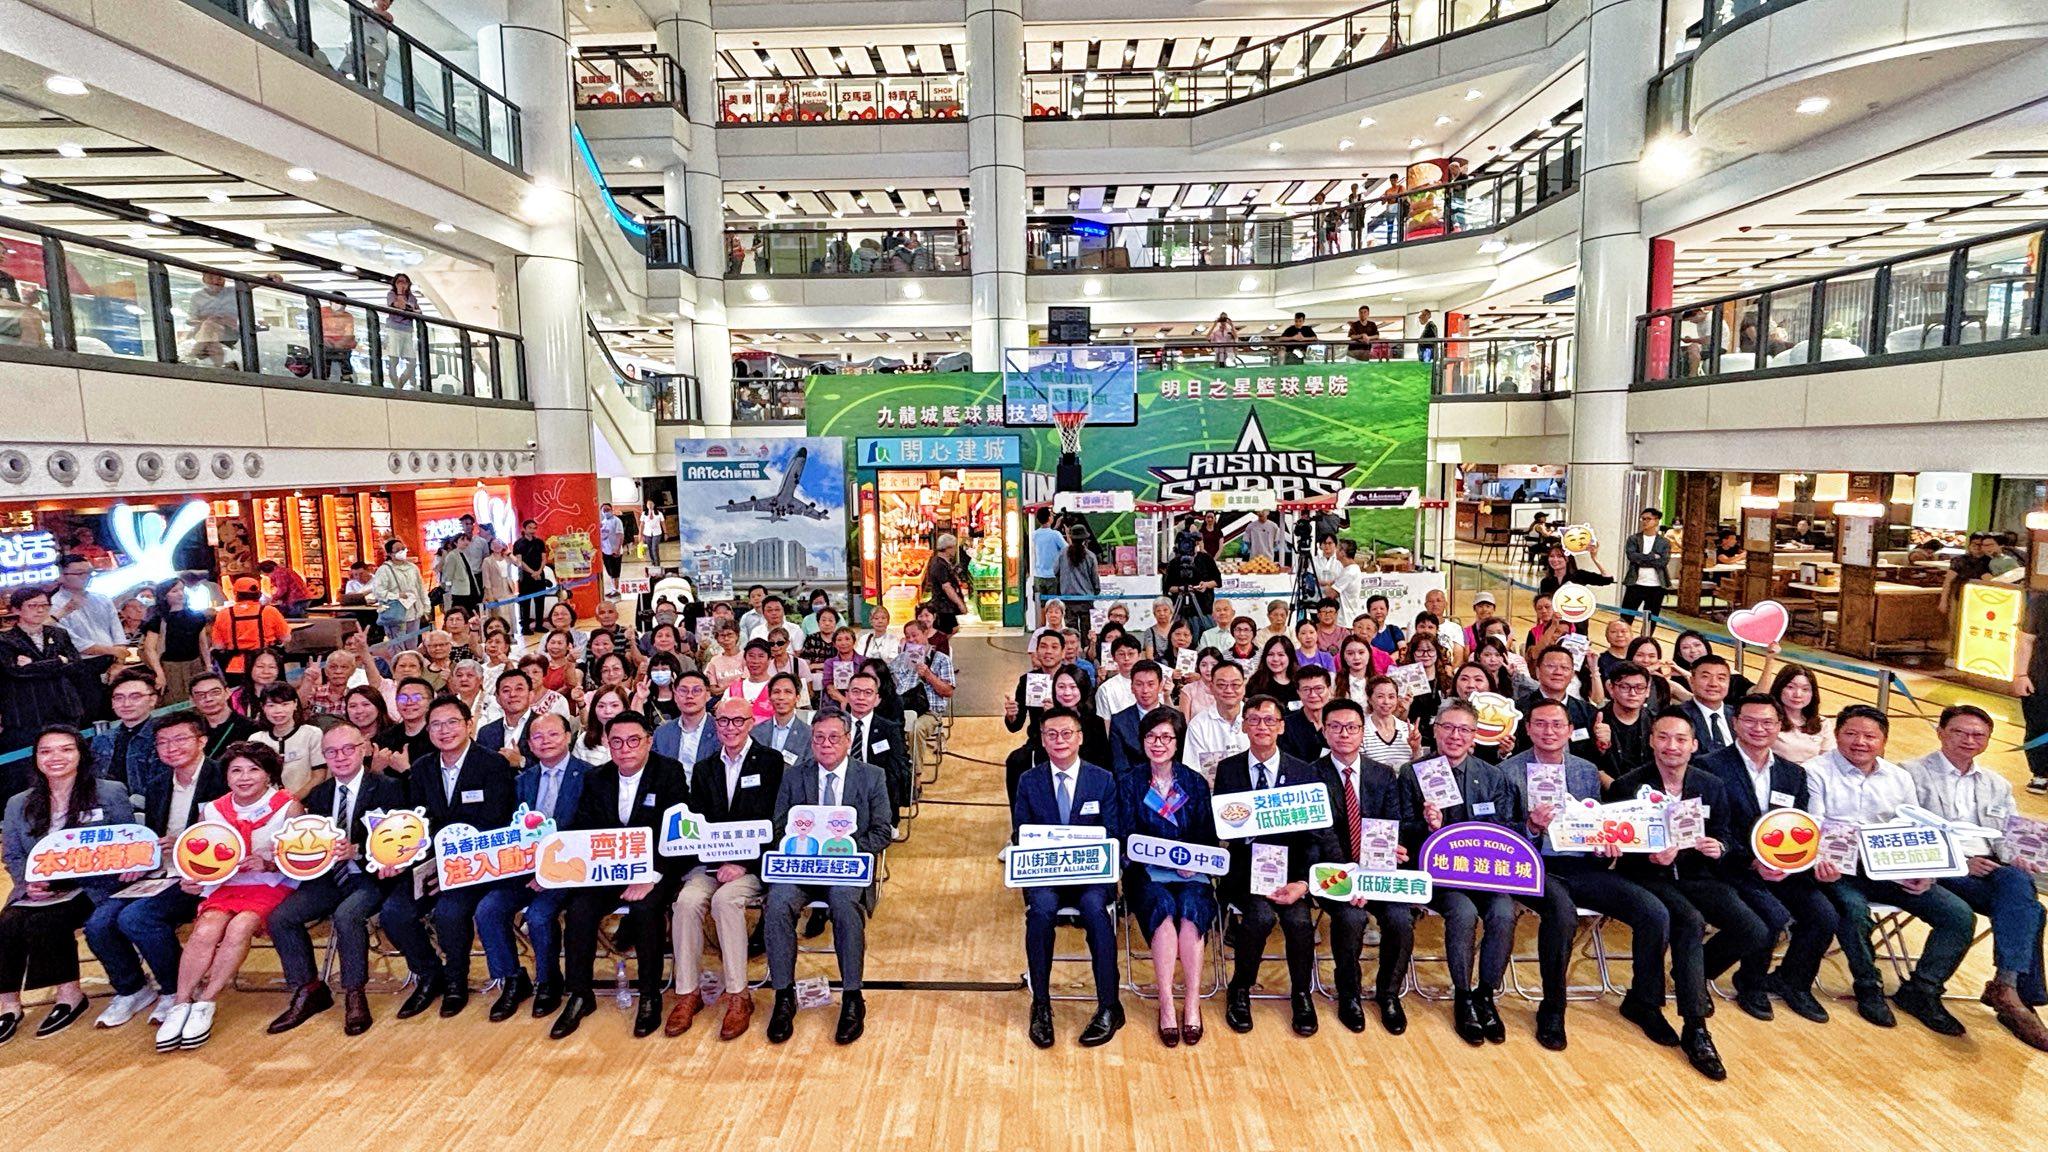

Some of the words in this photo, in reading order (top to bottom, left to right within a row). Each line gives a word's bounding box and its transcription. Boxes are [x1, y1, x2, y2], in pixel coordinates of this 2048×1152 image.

[933, 87, 953, 95] SHOP
[1161, 375, 1350, 399] 明日之星籃球學院
[877, 403, 1049, 429] 九龍城籃球競技場
[900, 438, 1006, 464] 開心建城
[687, 466, 734, 480] ARTech
[1189, 451, 1314, 478] RISING
[1253, 788, 1326, 810] 支援中小企
[1255, 804, 1329, 830] 低碳轉型
[79, 828, 114, 844] 帶動
[442, 829, 522, 857] 為香港經濟
[710, 828, 768, 841] 市區重建局
[1867, 830, 1939, 849] 激活香港
[590, 831, 647, 861] 齊撐
[697, 842, 735, 850] RENEWAL
[705, 848, 752, 857] AUTHORITY
[1132, 842, 1167, 858] CLP
[1193, 852, 1226, 870] 中電
[1448, 839, 1482, 851] HONG
[1483, 839, 1516, 855] KONG
[1873, 847, 1944, 866] 特色旅遊
[33, 840, 156, 877] 本地消費
[770, 858, 861, 875] 支持銀髮經濟
[1017, 848, 1100, 869] 小街道大聯盟
[1433, 853, 1533, 879] 地膽遊龍城
[591, 862, 648, 882] 小商戶
[1016, 866, 1062, 876] BACKSTREET
[1063, 864, 1100, 873] ALLIANCE
[1356, 874, 1428, 897] 低碳美食
